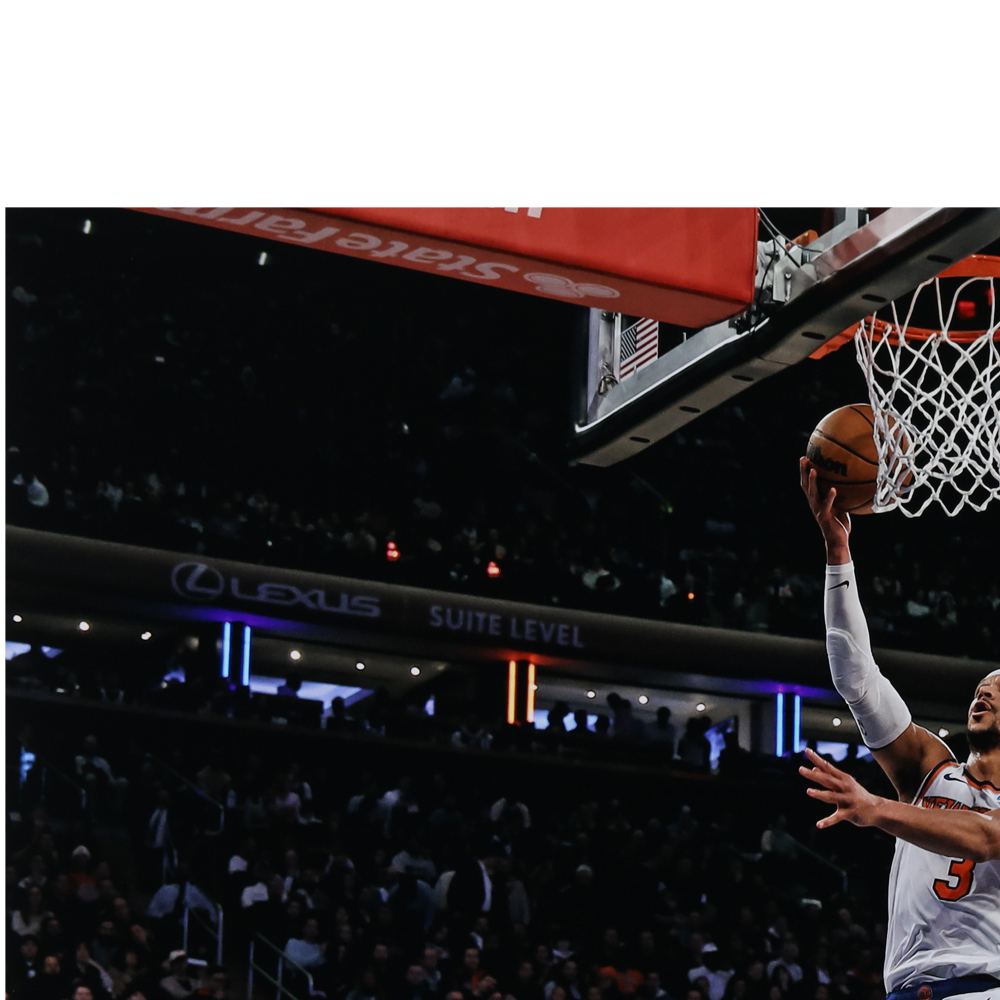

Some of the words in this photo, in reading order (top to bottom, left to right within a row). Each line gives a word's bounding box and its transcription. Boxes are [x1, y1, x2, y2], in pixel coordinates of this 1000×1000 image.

[231, 578, 380, 618] LEXUS
[429, 605, 501, 636] SUITE
[509, 618, 585, 649] LEVEL
[932, 859, 976, 902] 3
